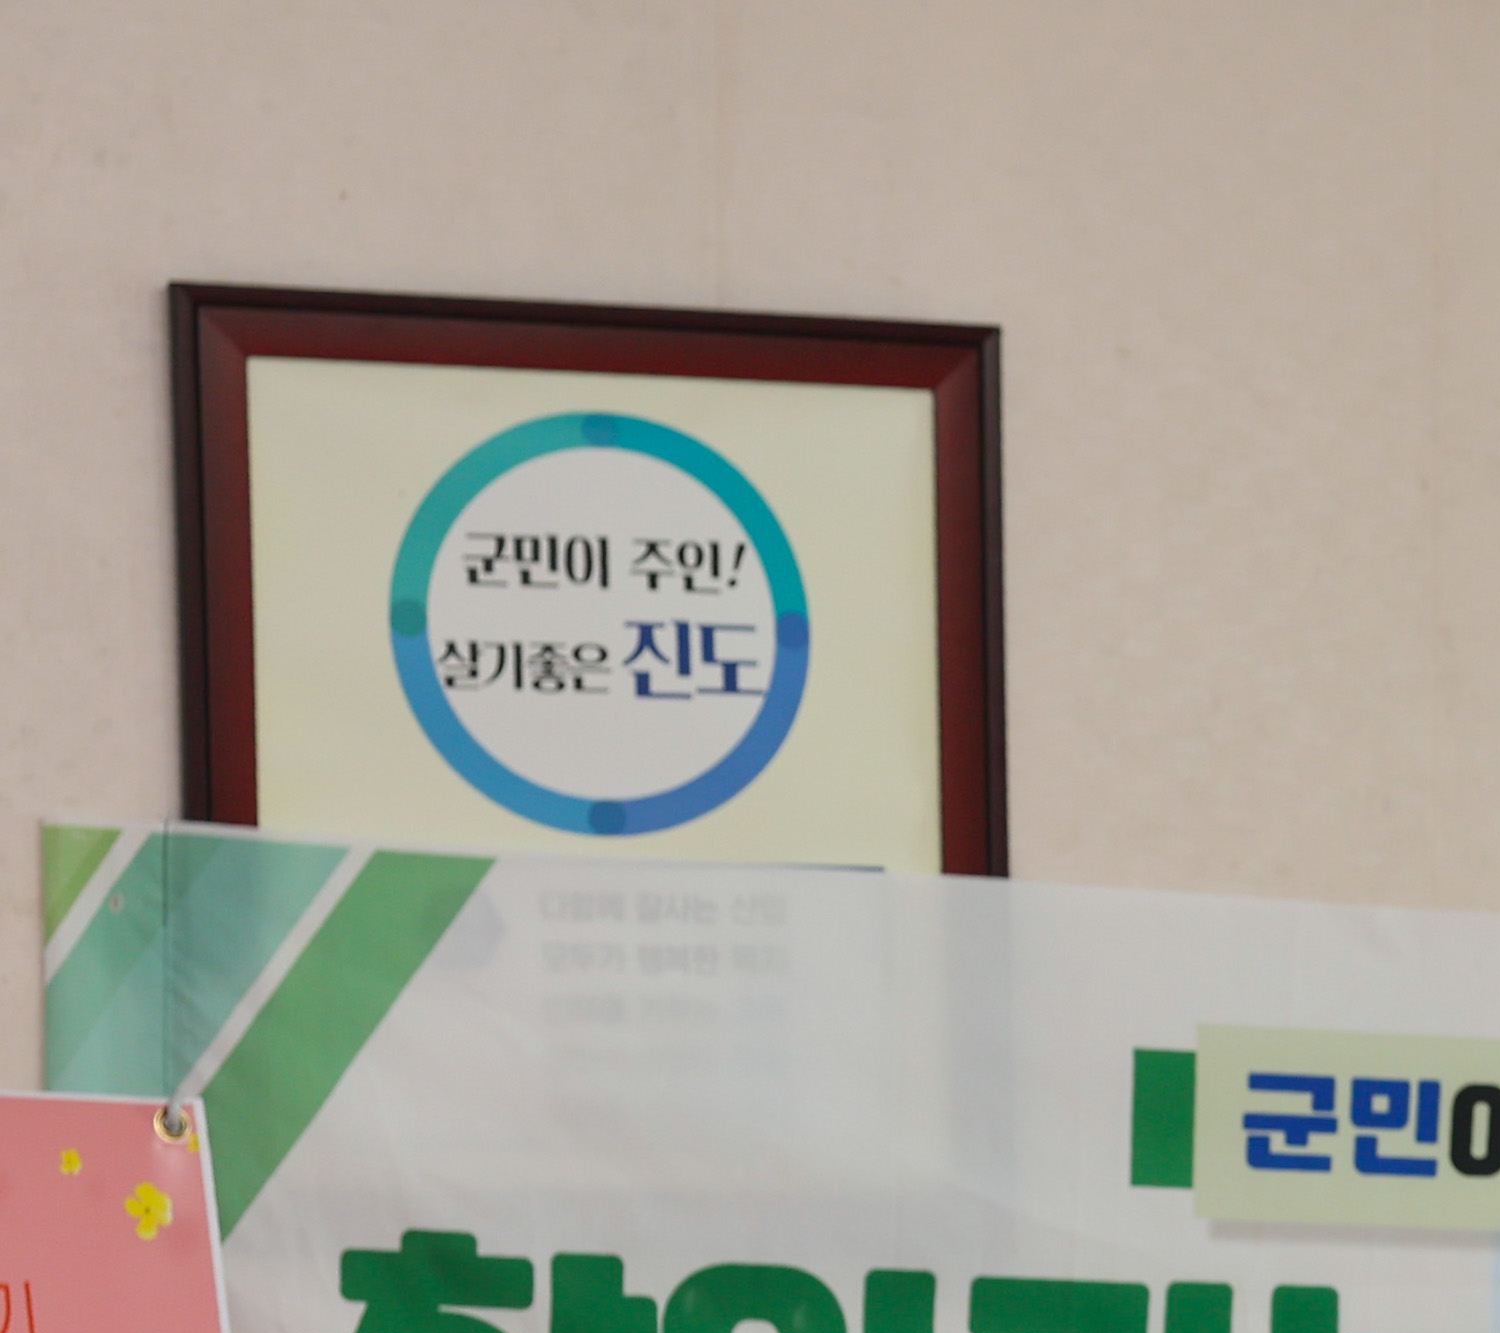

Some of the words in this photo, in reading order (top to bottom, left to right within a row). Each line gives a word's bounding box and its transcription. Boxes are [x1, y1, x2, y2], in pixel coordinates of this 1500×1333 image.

[464, 532, 610, 589] 군민이
[631, 538, 748, 596] 주인!
[438, 640, 612, 694] 살기좋은
[620, 619, 765, 701] 진도
